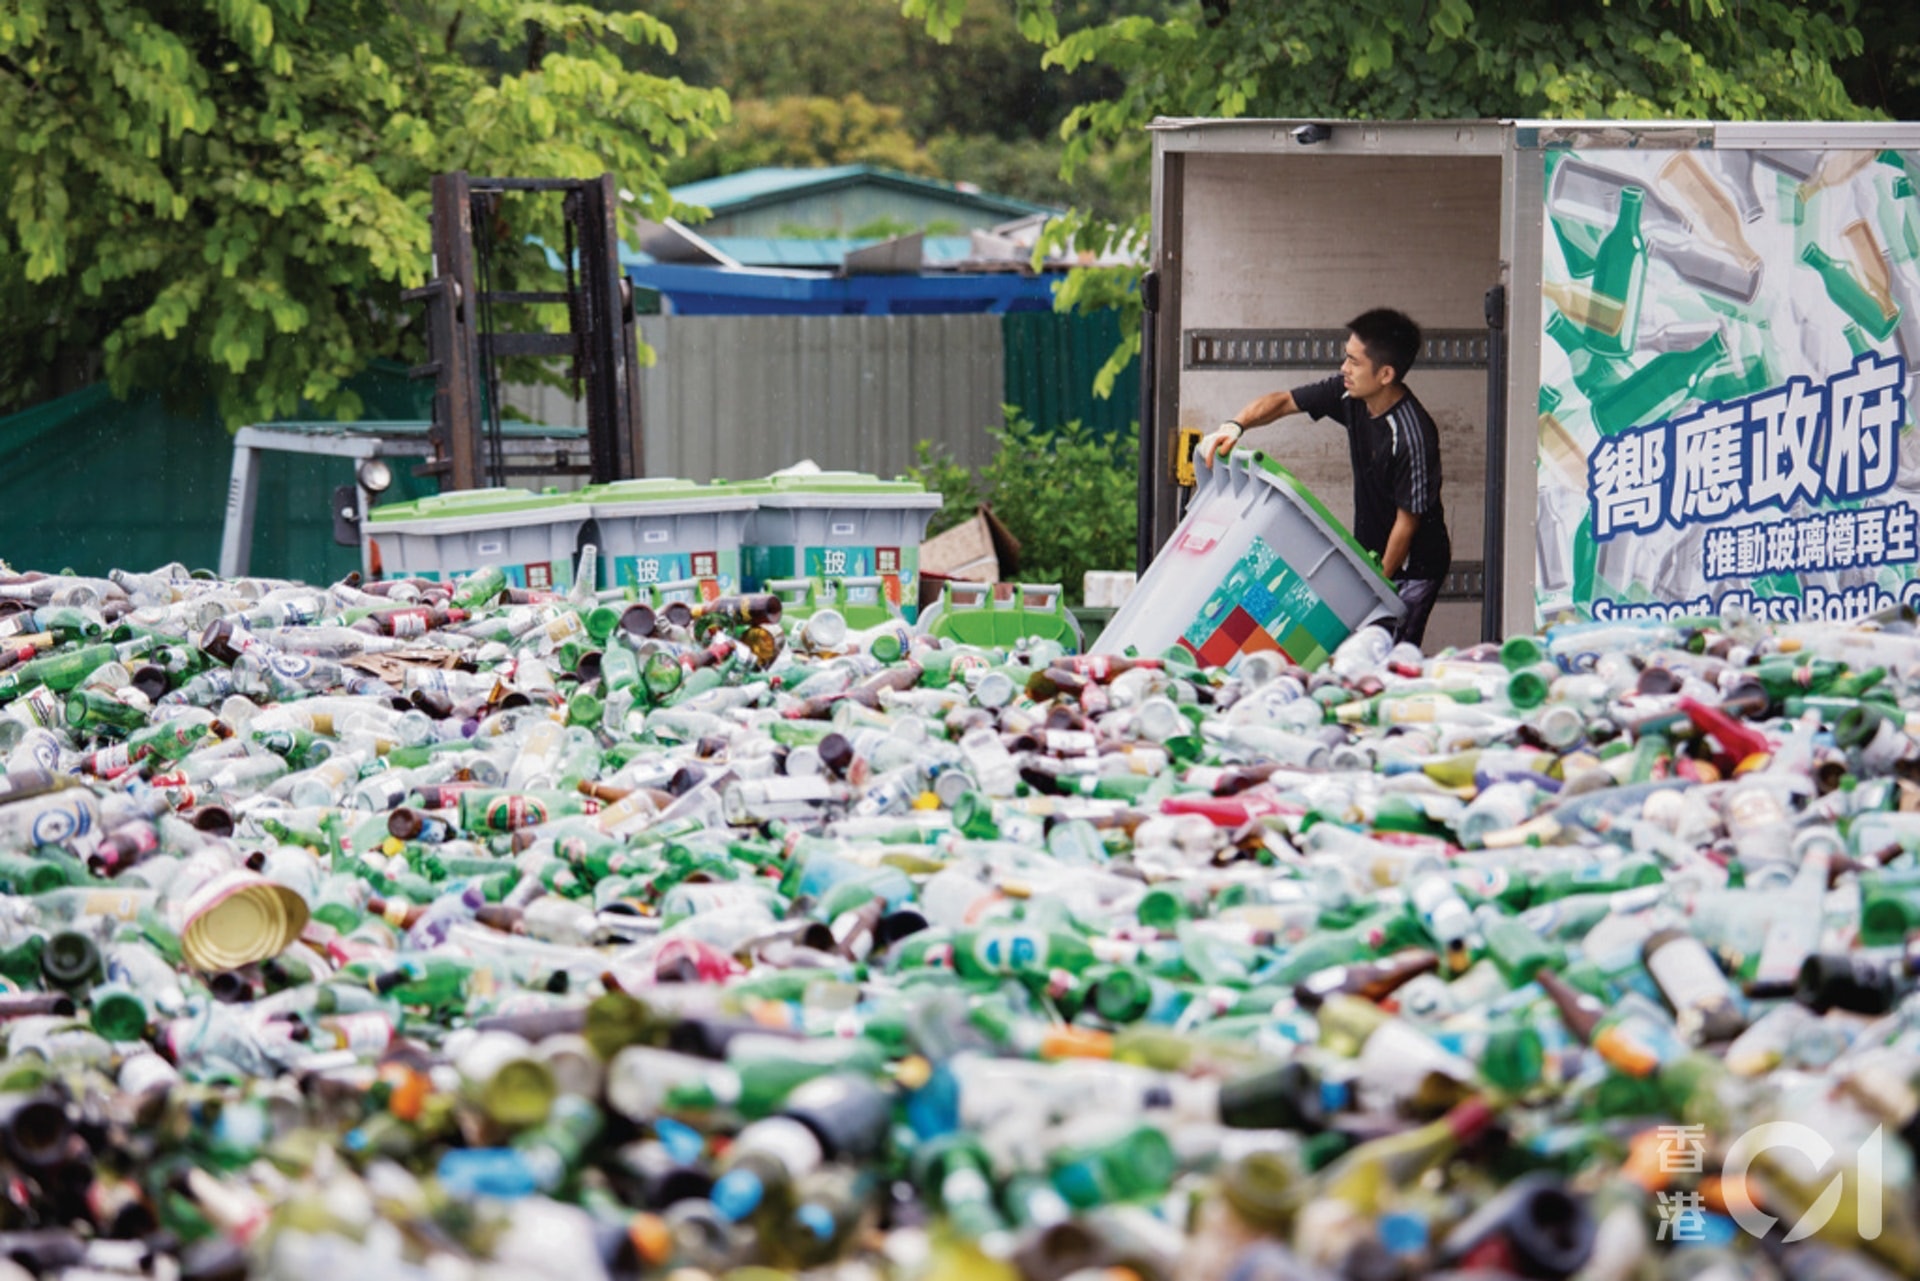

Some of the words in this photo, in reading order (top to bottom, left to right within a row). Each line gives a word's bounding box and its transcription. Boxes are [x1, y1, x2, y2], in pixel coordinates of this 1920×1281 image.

[1590, 358, 1902, 537] 嚮應政府
[1704, 504, 1917, 579] 推動玻璃樽再生
[1804, 584, 1896, 624] Bottle
